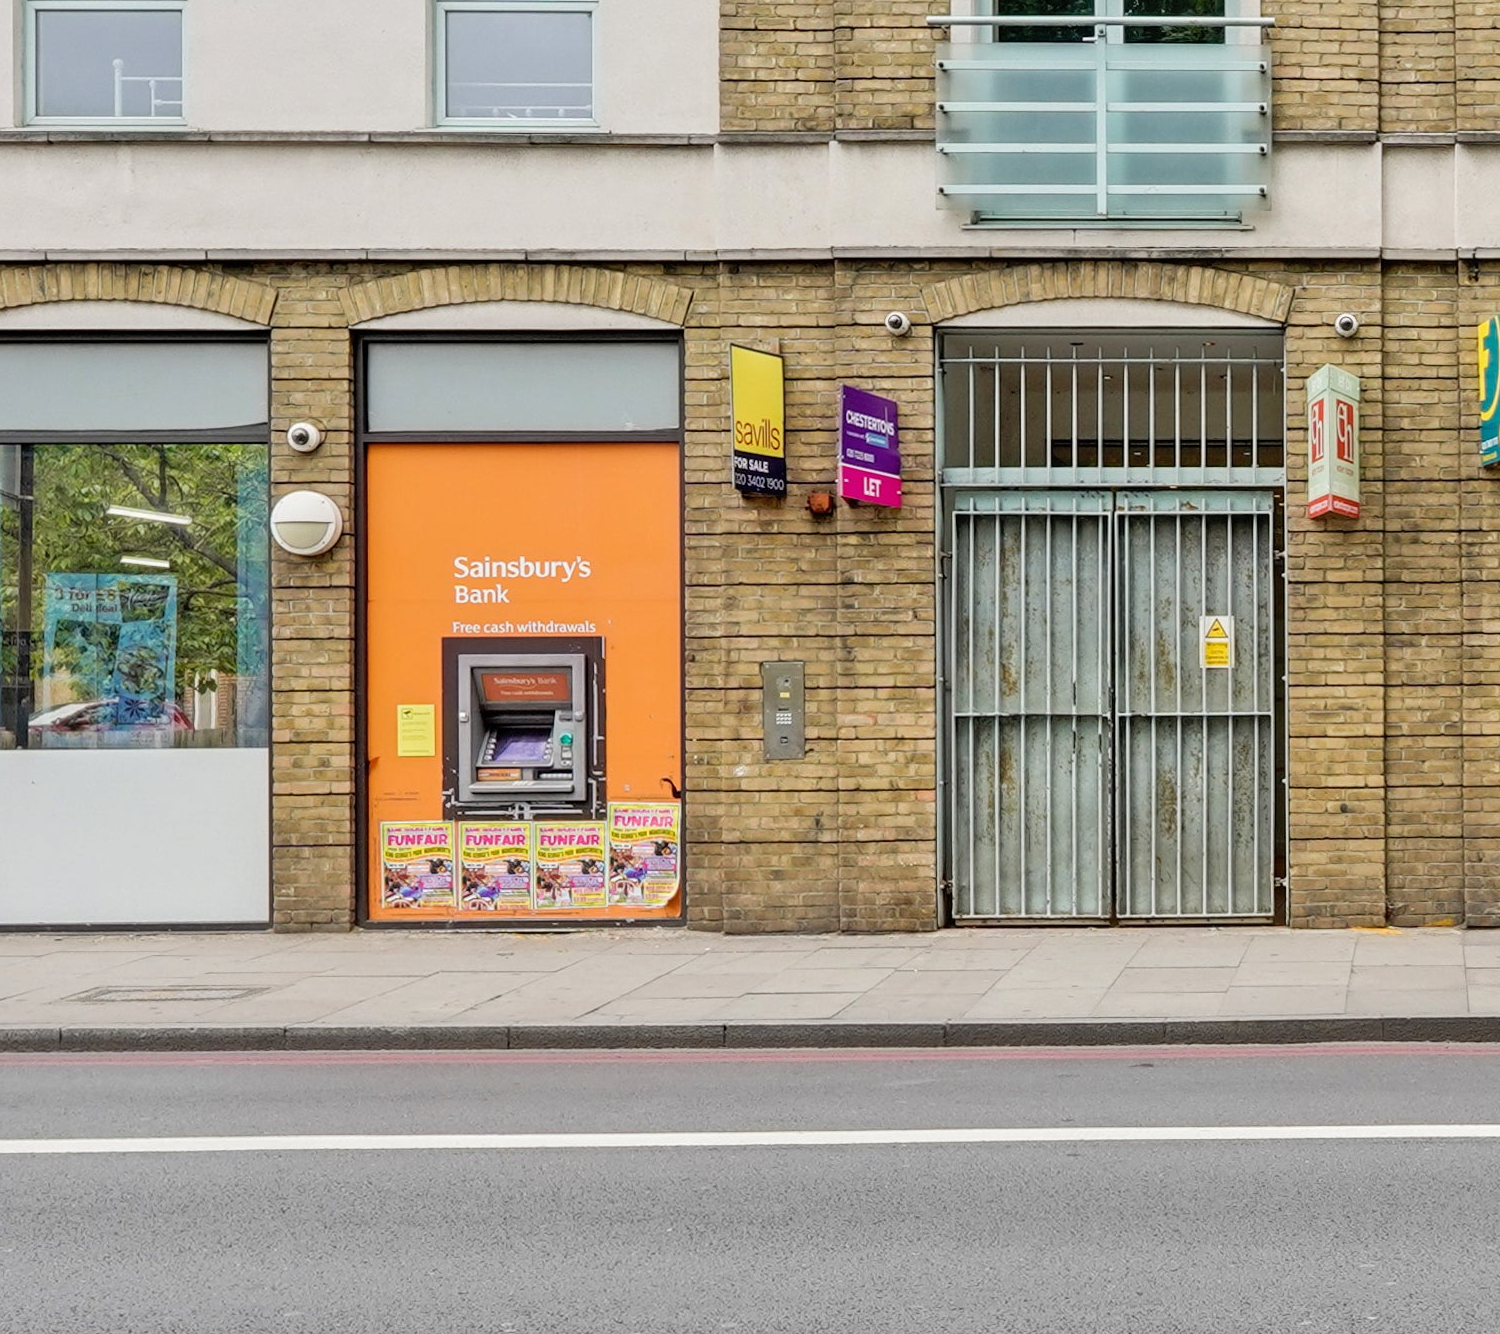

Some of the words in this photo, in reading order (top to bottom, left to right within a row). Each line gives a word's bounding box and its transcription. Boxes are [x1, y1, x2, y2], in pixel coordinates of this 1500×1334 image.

[846, 410, 895, 436] CHESTERTONS
[736, 419, 780, 450] savills
[734, 457, 748, 470] FOR
[748, 459, 769, 473] SALE
[747, 475, 766, 489] 3402
[766, 477, 784, 491] 1900
[864, 477, 882, 497] LET
[454, 556, 591, 583] Sainsbury's
[454, 584, 510, 603] Bank
[452, 621, 480, 633] Free
[484, 621, 514, 633] cash
[517, 621, 596, 633] withdrawals
[614, 815, 673, 827] FUNFAIR
[388, 833, 448, 846] FUNFAIR
[466, 833, 526, 846] FUNFAIR
[540, 834, 600, 846] FUNFAIR
